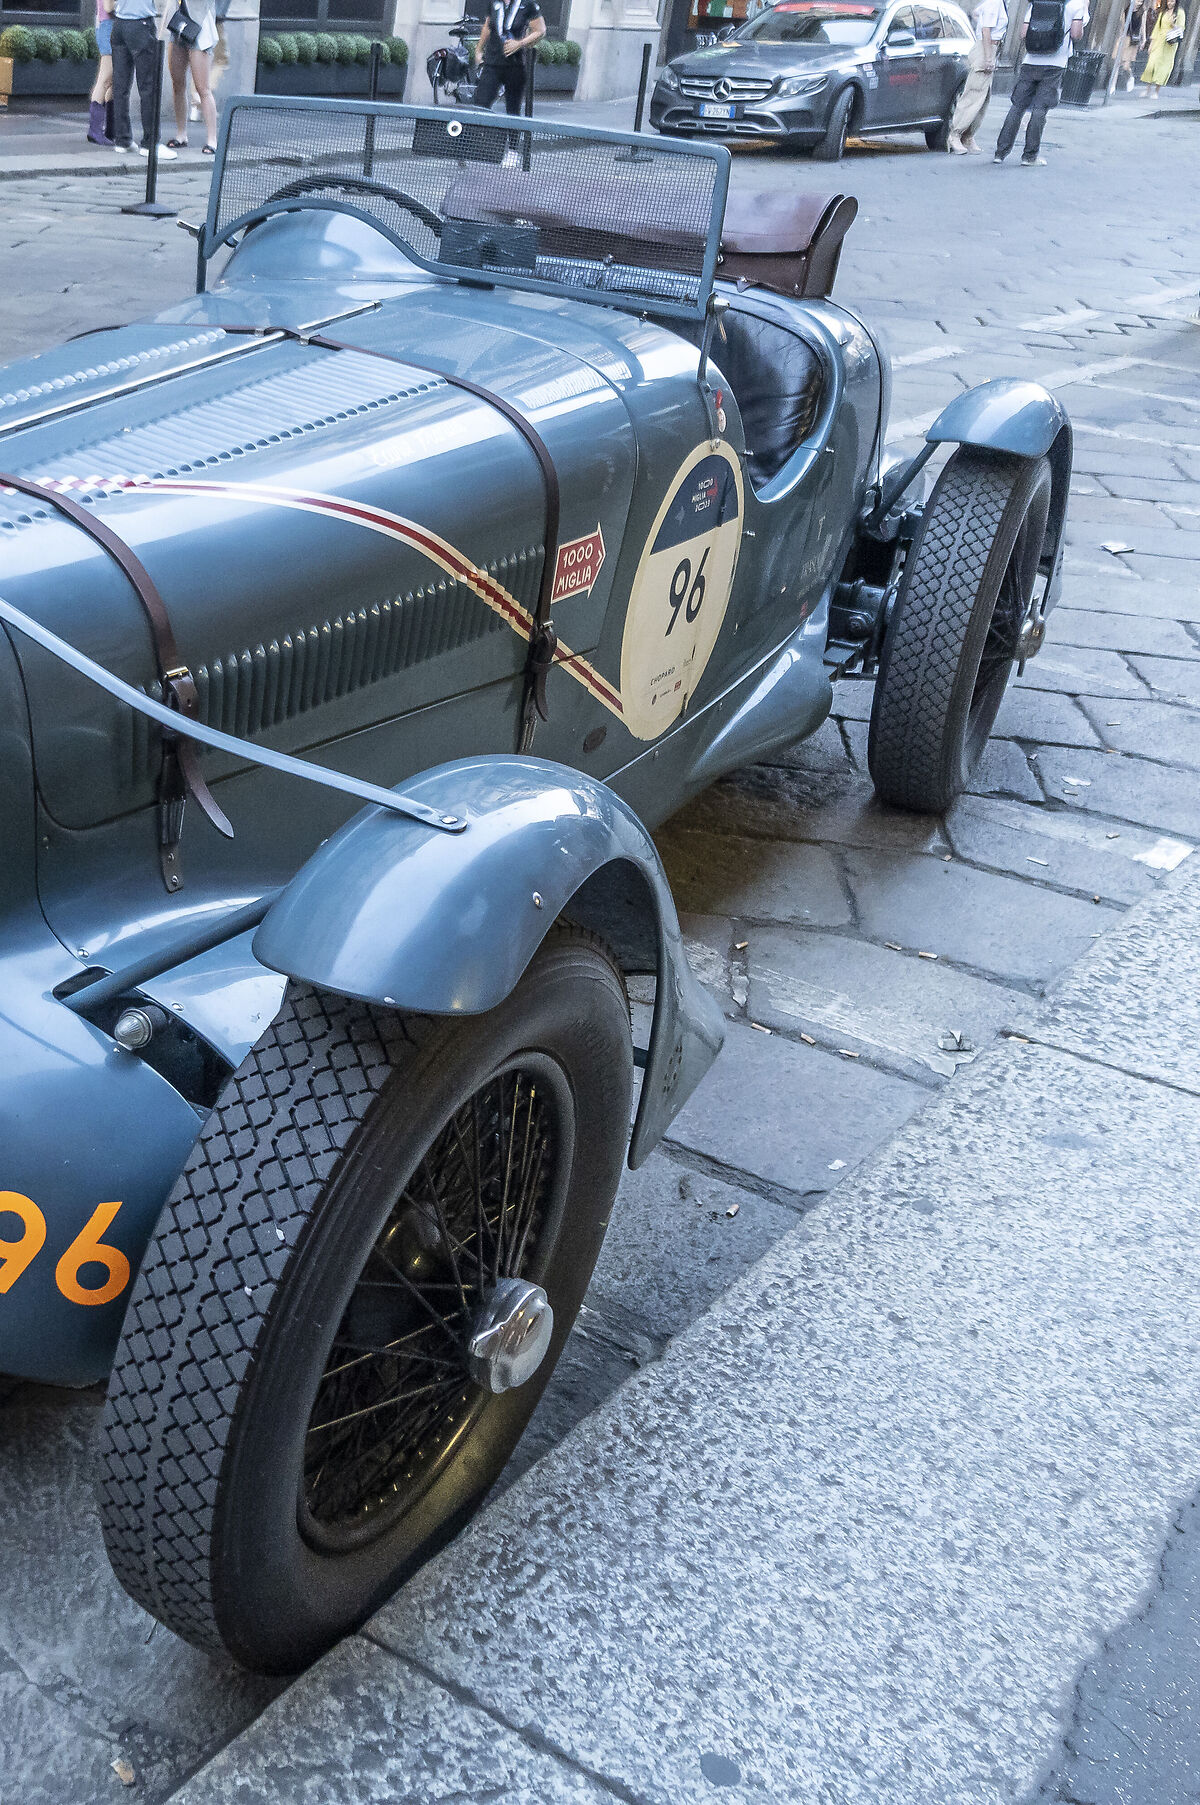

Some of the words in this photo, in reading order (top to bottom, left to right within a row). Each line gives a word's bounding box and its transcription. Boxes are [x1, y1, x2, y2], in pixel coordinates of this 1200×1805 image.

[563, 543, 593, 569] 1000
[556, 565, 592, 594] MIGLIA
[664, 546, 711, 637] 96
[650, 666, 676, 686] CHOPARD
